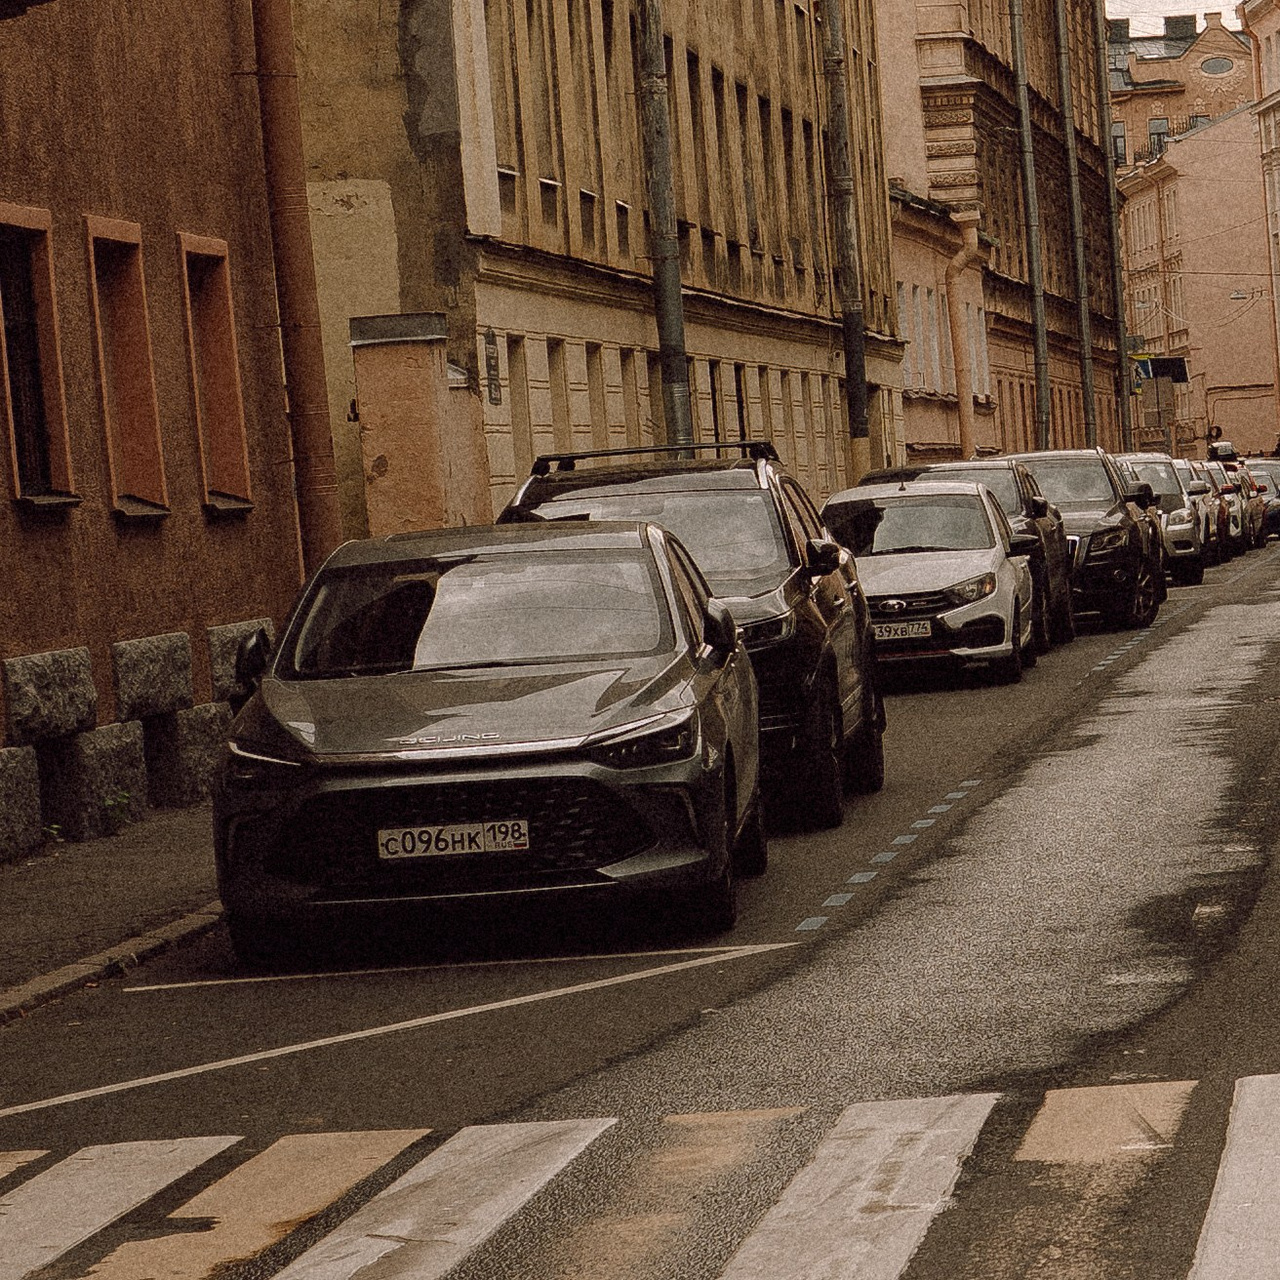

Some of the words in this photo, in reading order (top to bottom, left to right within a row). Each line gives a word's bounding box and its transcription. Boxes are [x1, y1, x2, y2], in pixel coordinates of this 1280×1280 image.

[876, 625, 908, 638] 39ХВ
[384, 829, 482, 856] С096НК
[486, 822, 522, 842] 198
[495, 841, 513, 849] RUS
